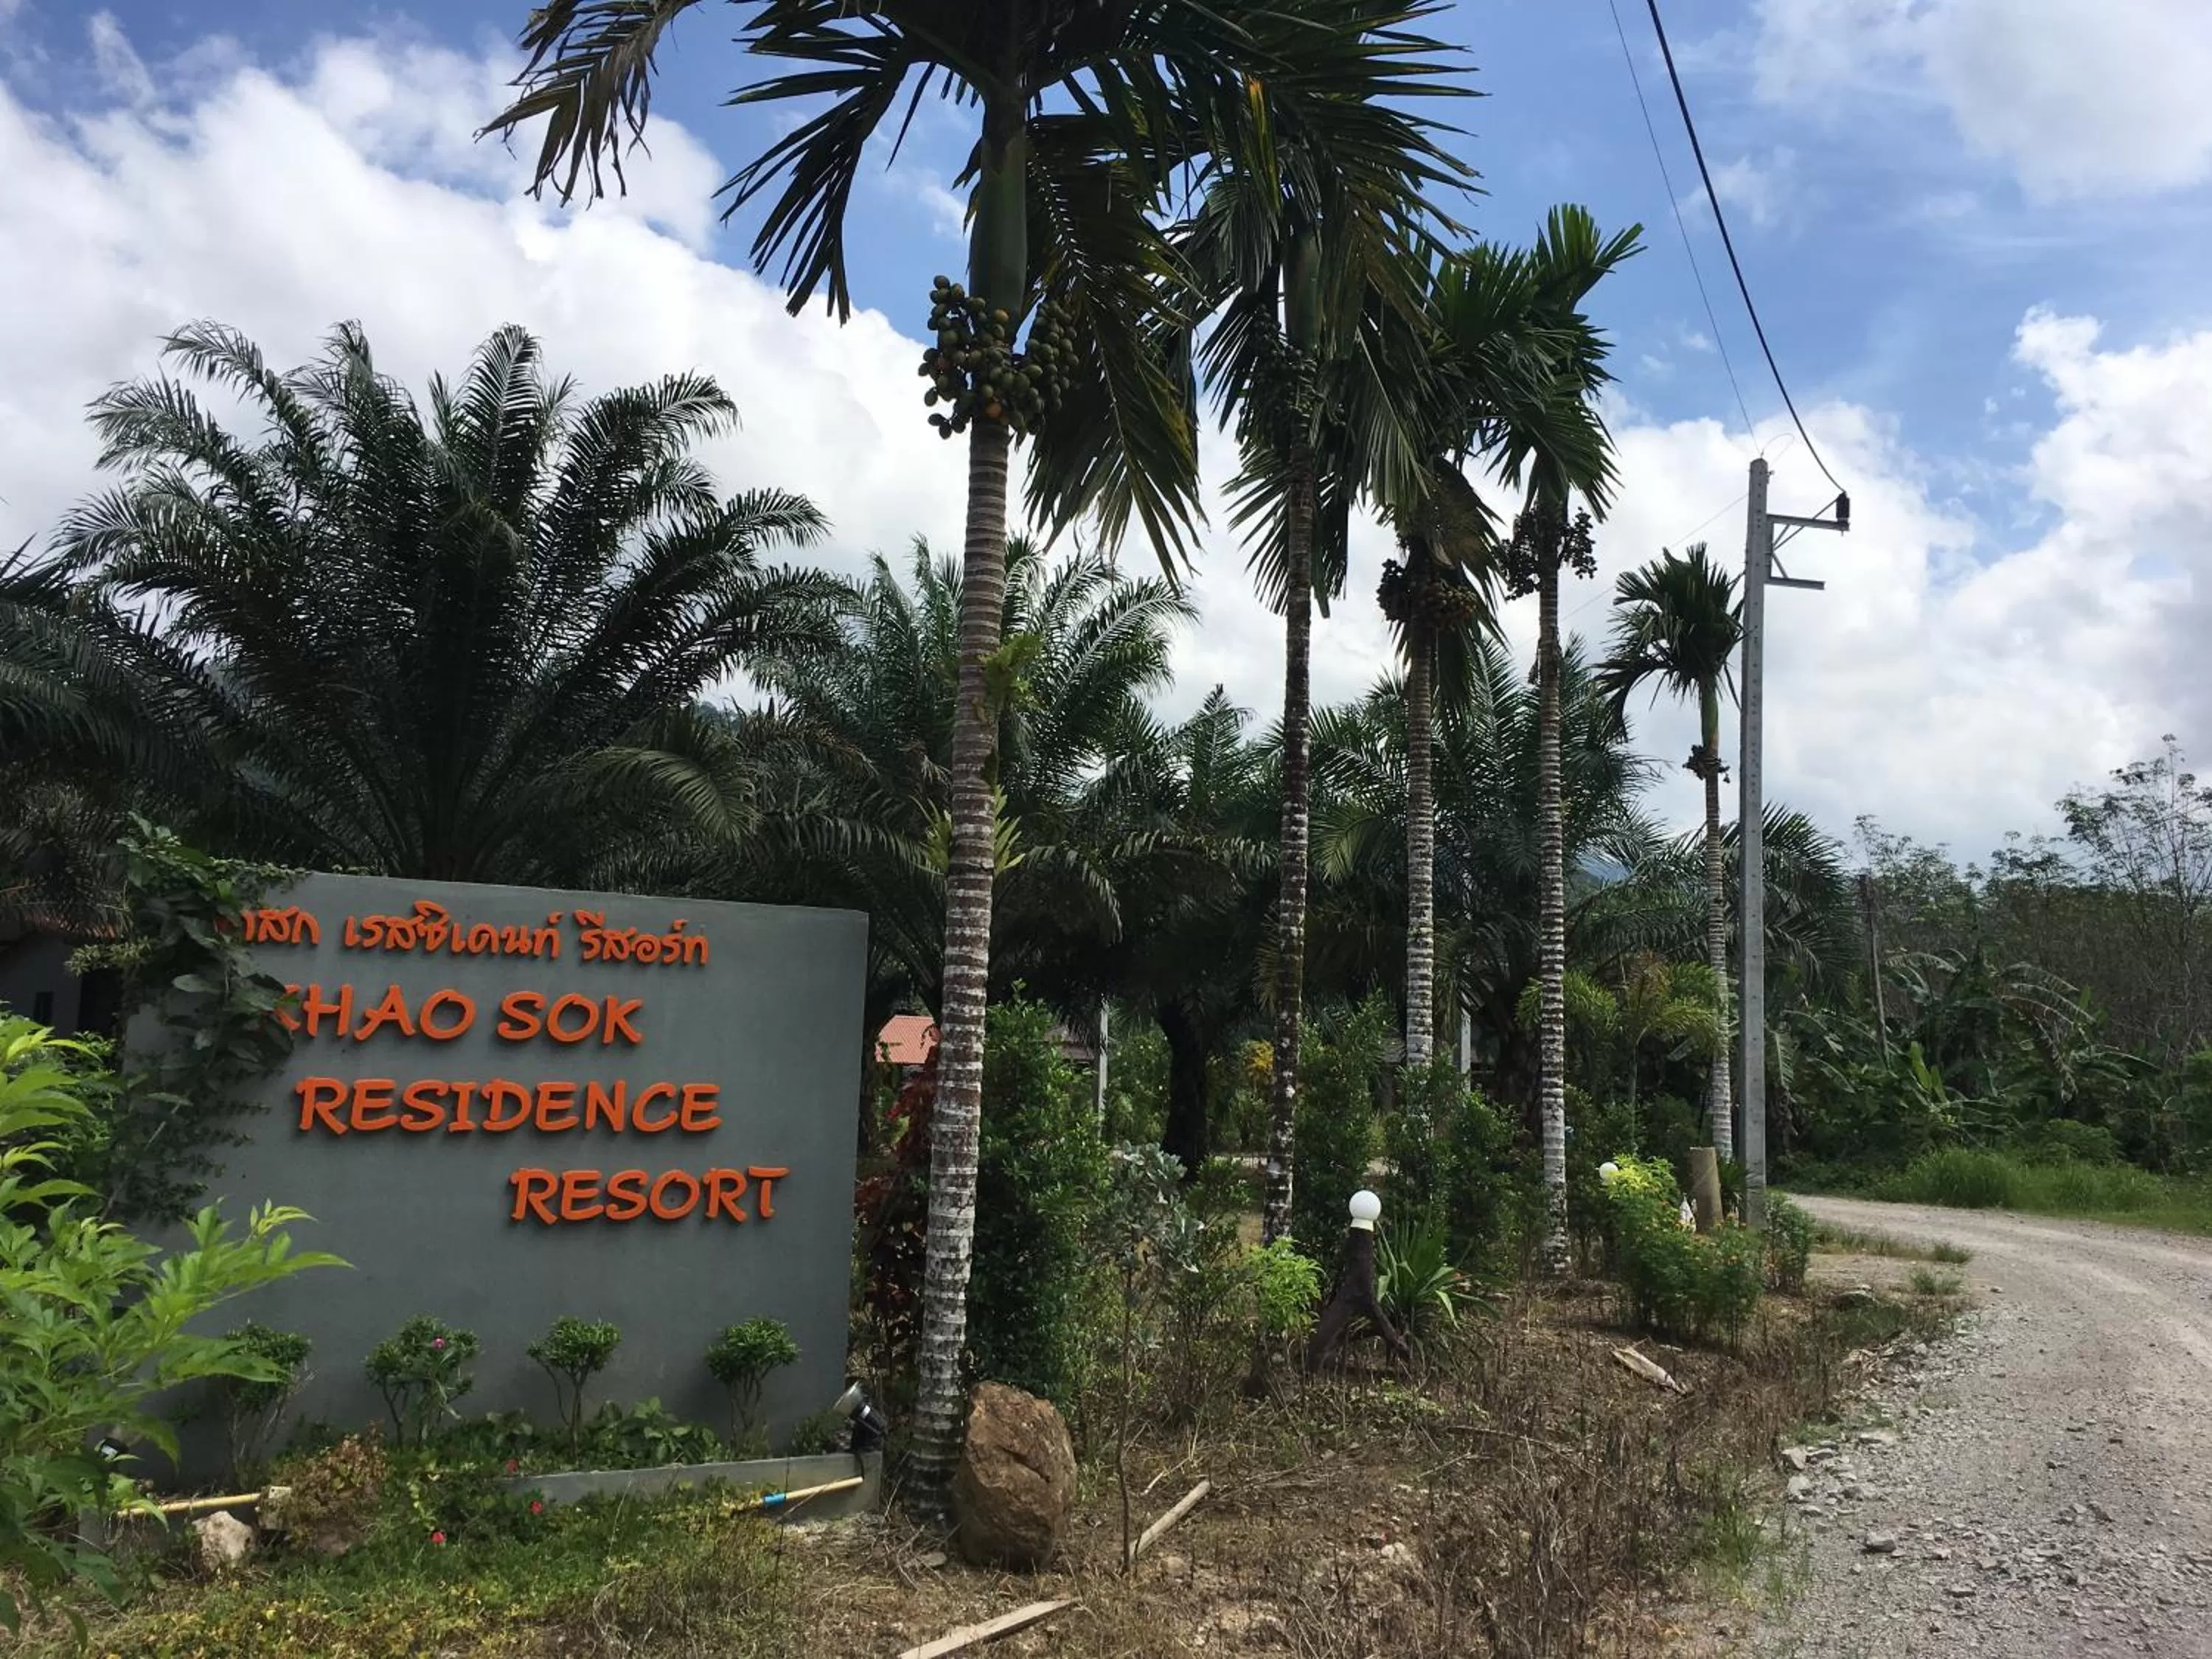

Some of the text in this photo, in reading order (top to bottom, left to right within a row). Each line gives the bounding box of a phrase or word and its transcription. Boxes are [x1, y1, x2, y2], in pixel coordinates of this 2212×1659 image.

[215, 905, 321, 945] าสก
[497, 991, 643, 1044] SOK
[295, 1077, 723, 1135] RESIDENCE
[510, 1166, 789, 1225] RESORT
